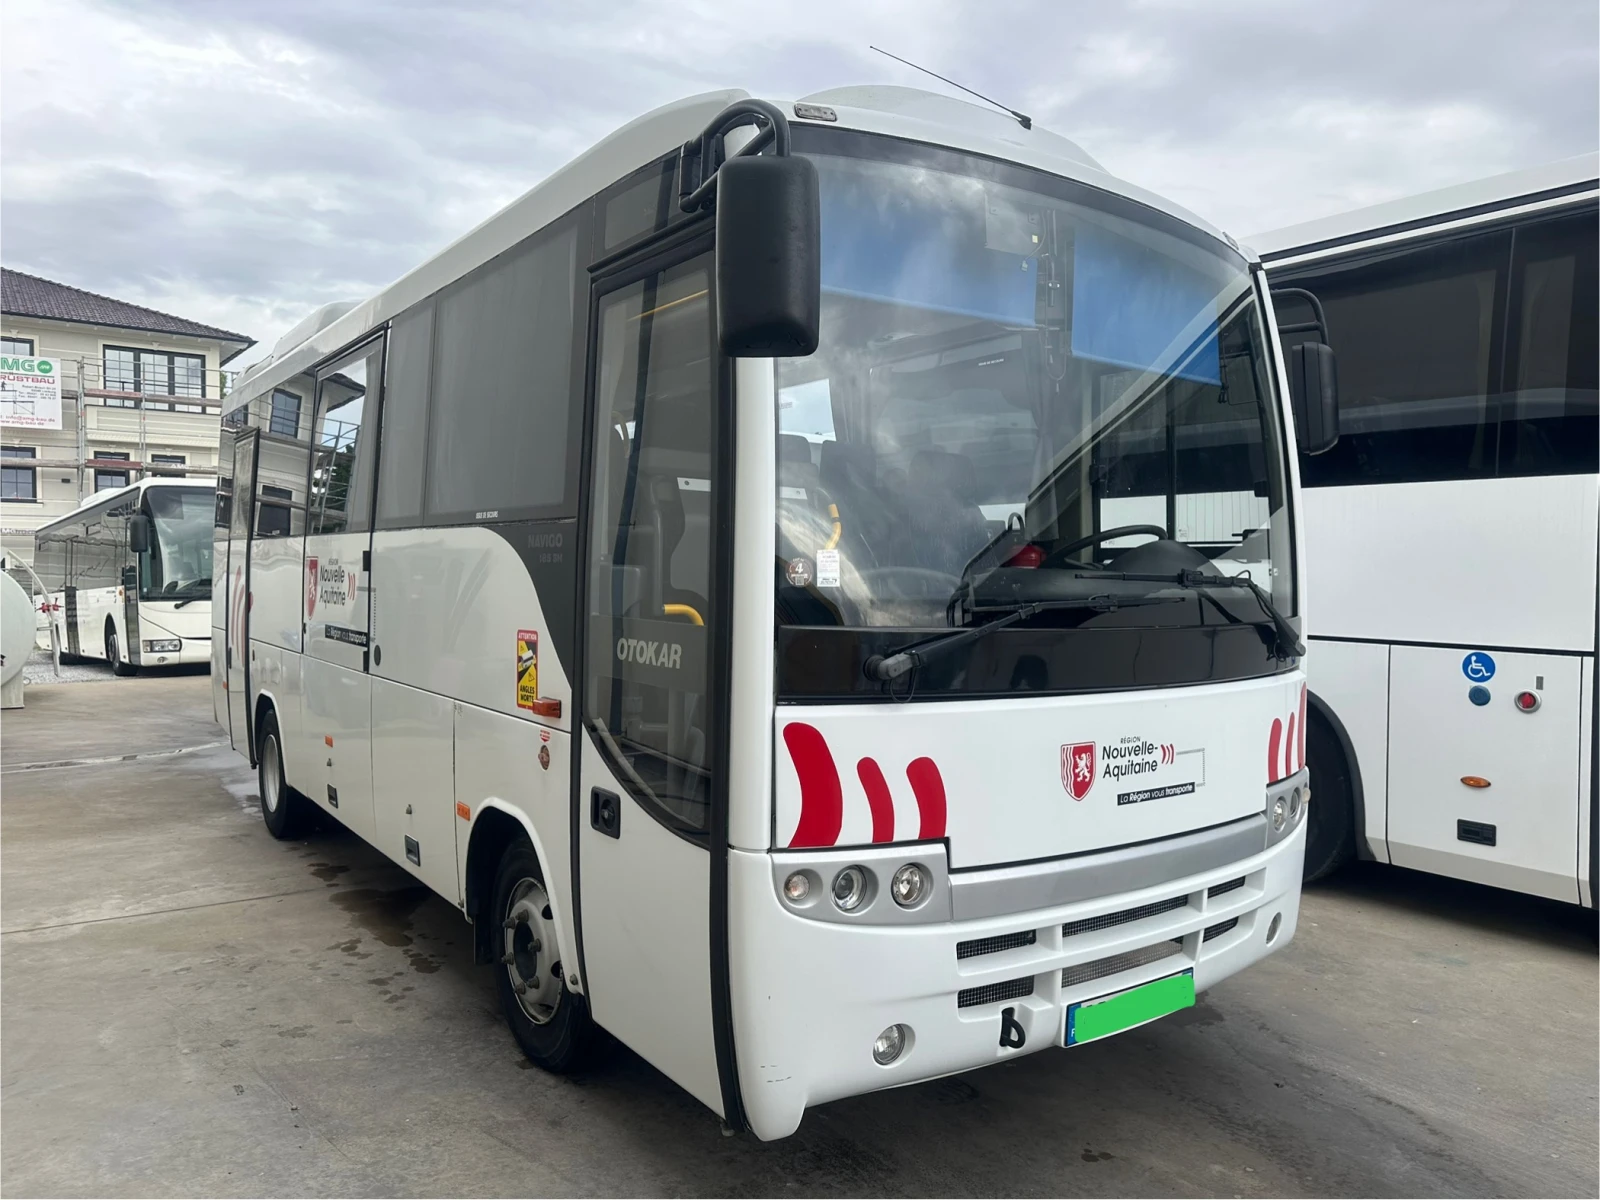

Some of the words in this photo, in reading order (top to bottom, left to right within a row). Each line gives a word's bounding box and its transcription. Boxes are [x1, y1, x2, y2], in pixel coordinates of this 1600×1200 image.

[528, 533, 563, 548] NAVIGO
[795, 562, 804, 573] 4
[319, 586, 346, 609] Aquitaine
[518, 632, 537, 641] ATTENTION
[616, 638, 682, 669] OTOKAR
[520, 685, 535, 695] ANGLES
[1120, 736, 1141, 744] RÉGION
[1102, 741, 1158, 760] Nouvelle-
[1102, 759, 1158, 782] Aquitaine
[1120, 794, 1128, 803] La
[1129, 791, 1151, 803] Région
[1151, 789, 1165, 798] vous
[1165, 784, 1193, 796] transporte
